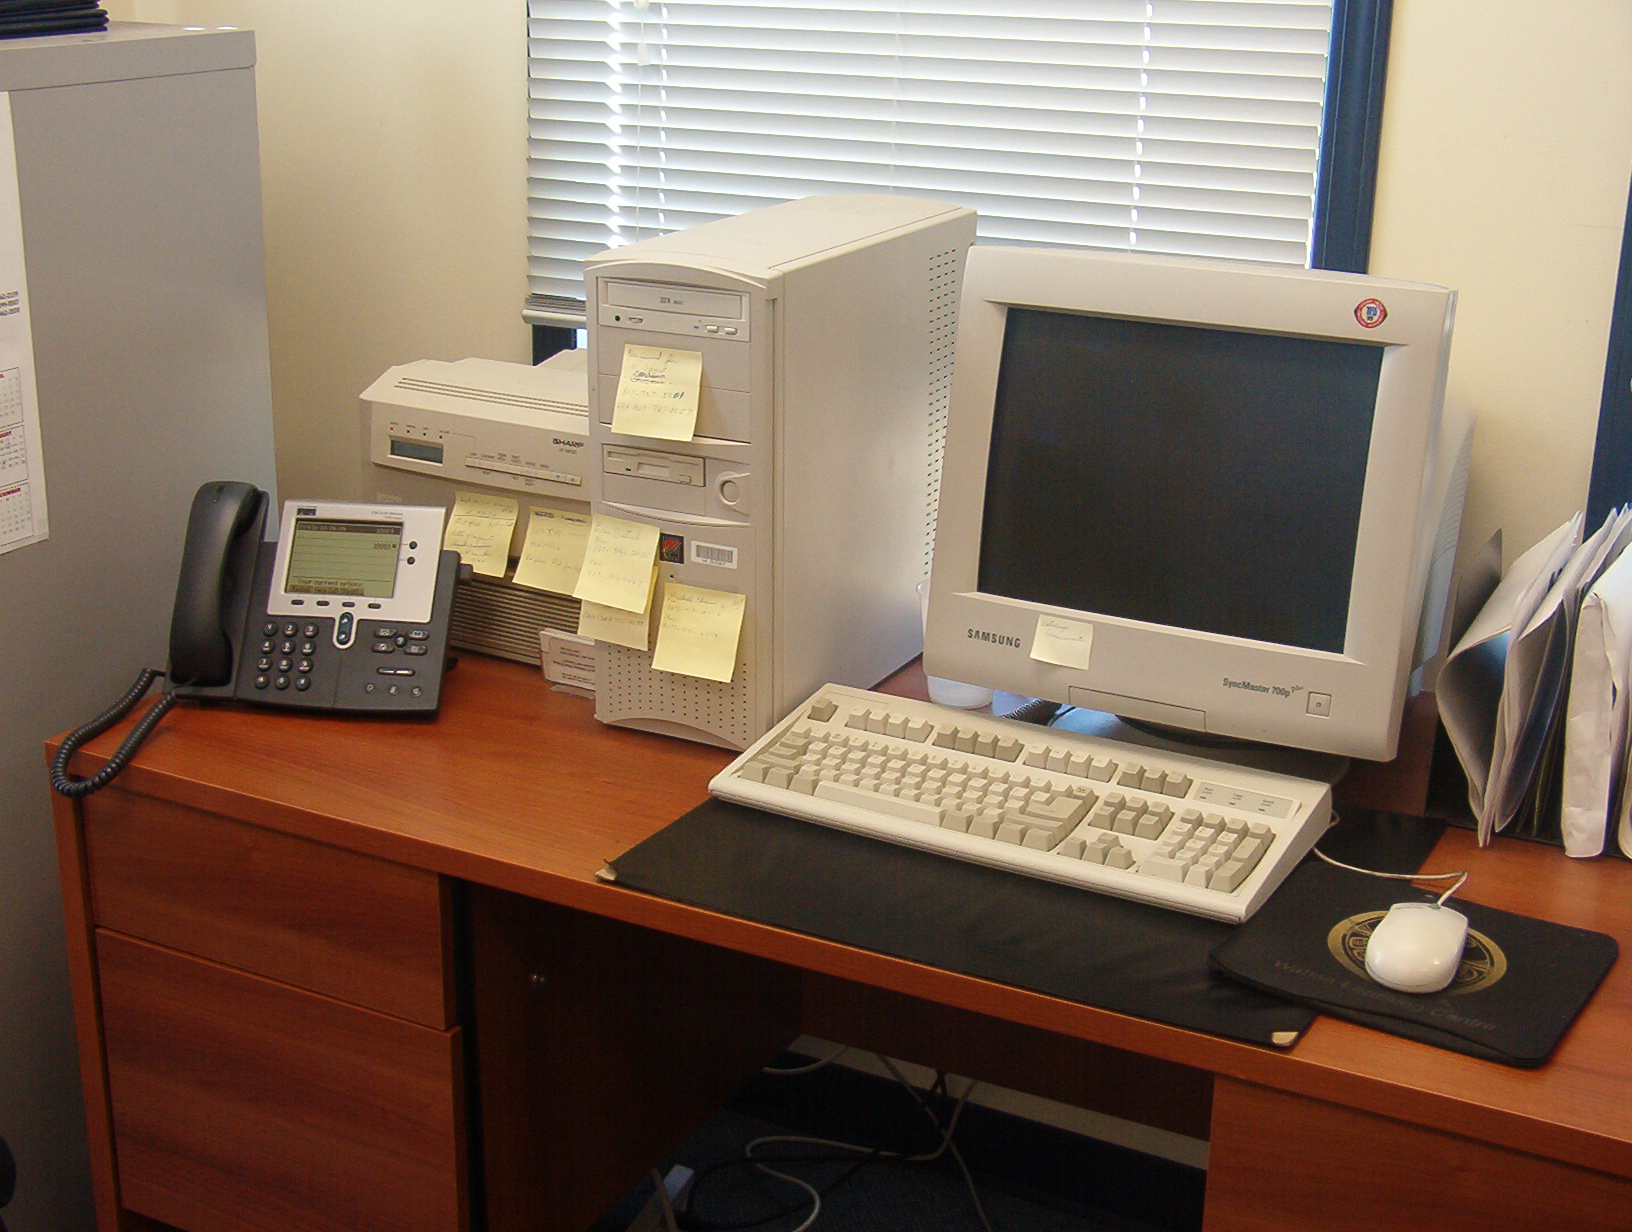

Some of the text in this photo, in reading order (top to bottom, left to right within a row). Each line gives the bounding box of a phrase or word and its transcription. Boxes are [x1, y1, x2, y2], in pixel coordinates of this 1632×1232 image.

[552, 438, 584, 448] SHARP
[967, 628, 1021, 648] SAMSUNG
[1222, 677, 1270, 694] SyncMaster
